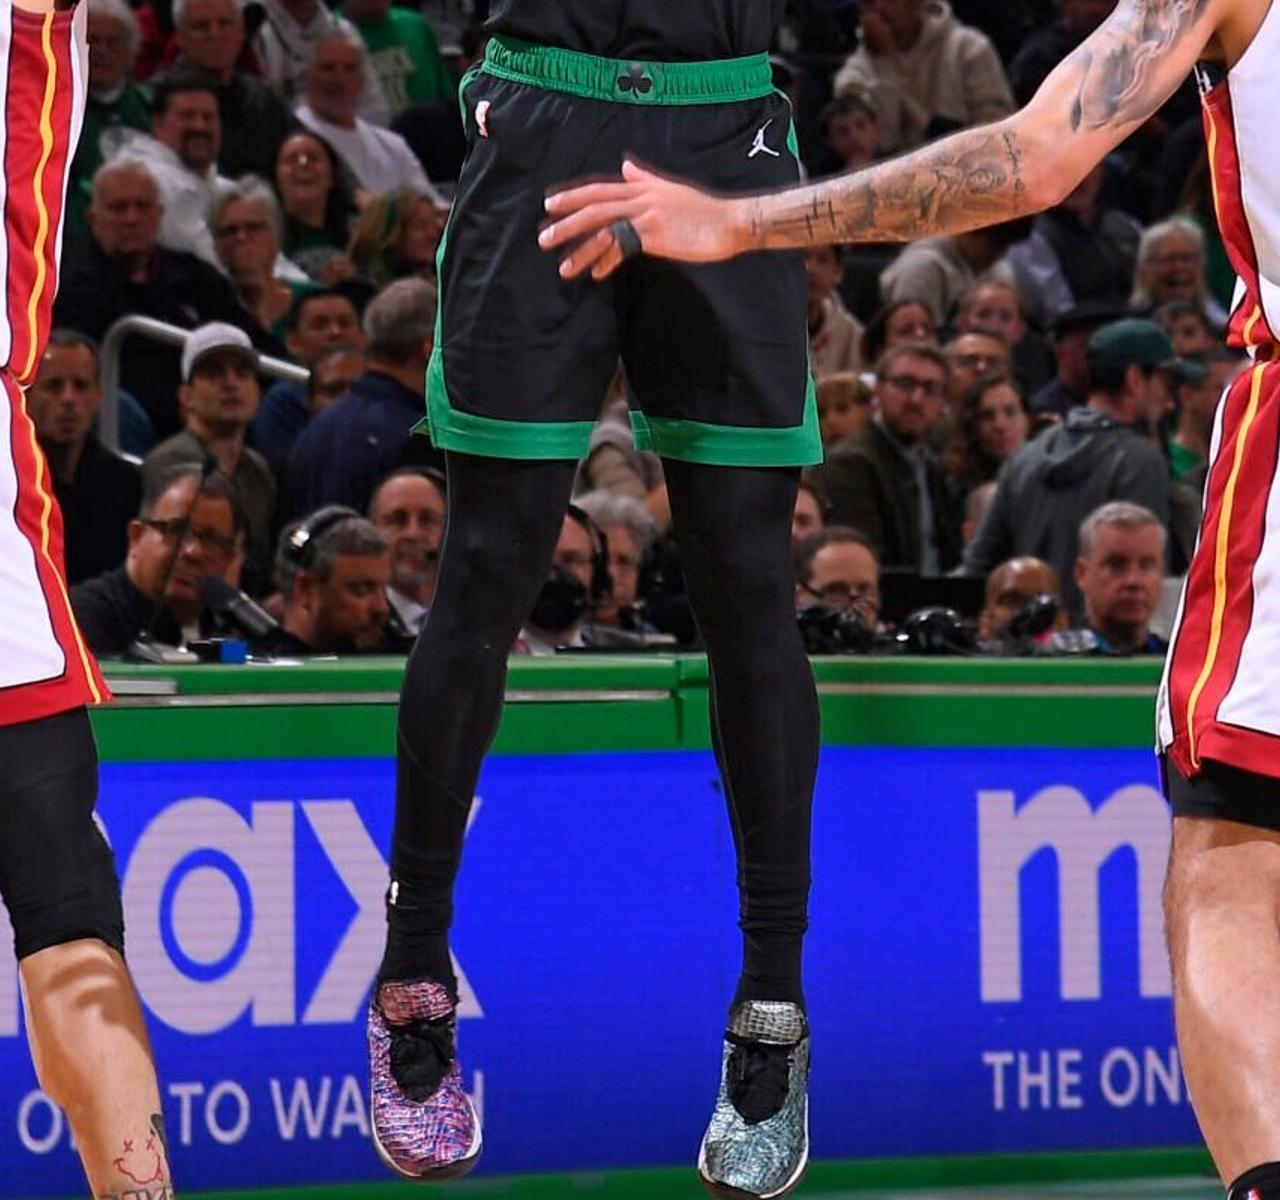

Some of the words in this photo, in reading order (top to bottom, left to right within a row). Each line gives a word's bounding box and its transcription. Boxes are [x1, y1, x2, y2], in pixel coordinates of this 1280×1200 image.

[982, 1049, 1084, 1112] THE
[1099, 1046, 1195, 1108] ON
[168, 1079, 251, 1146] TO
